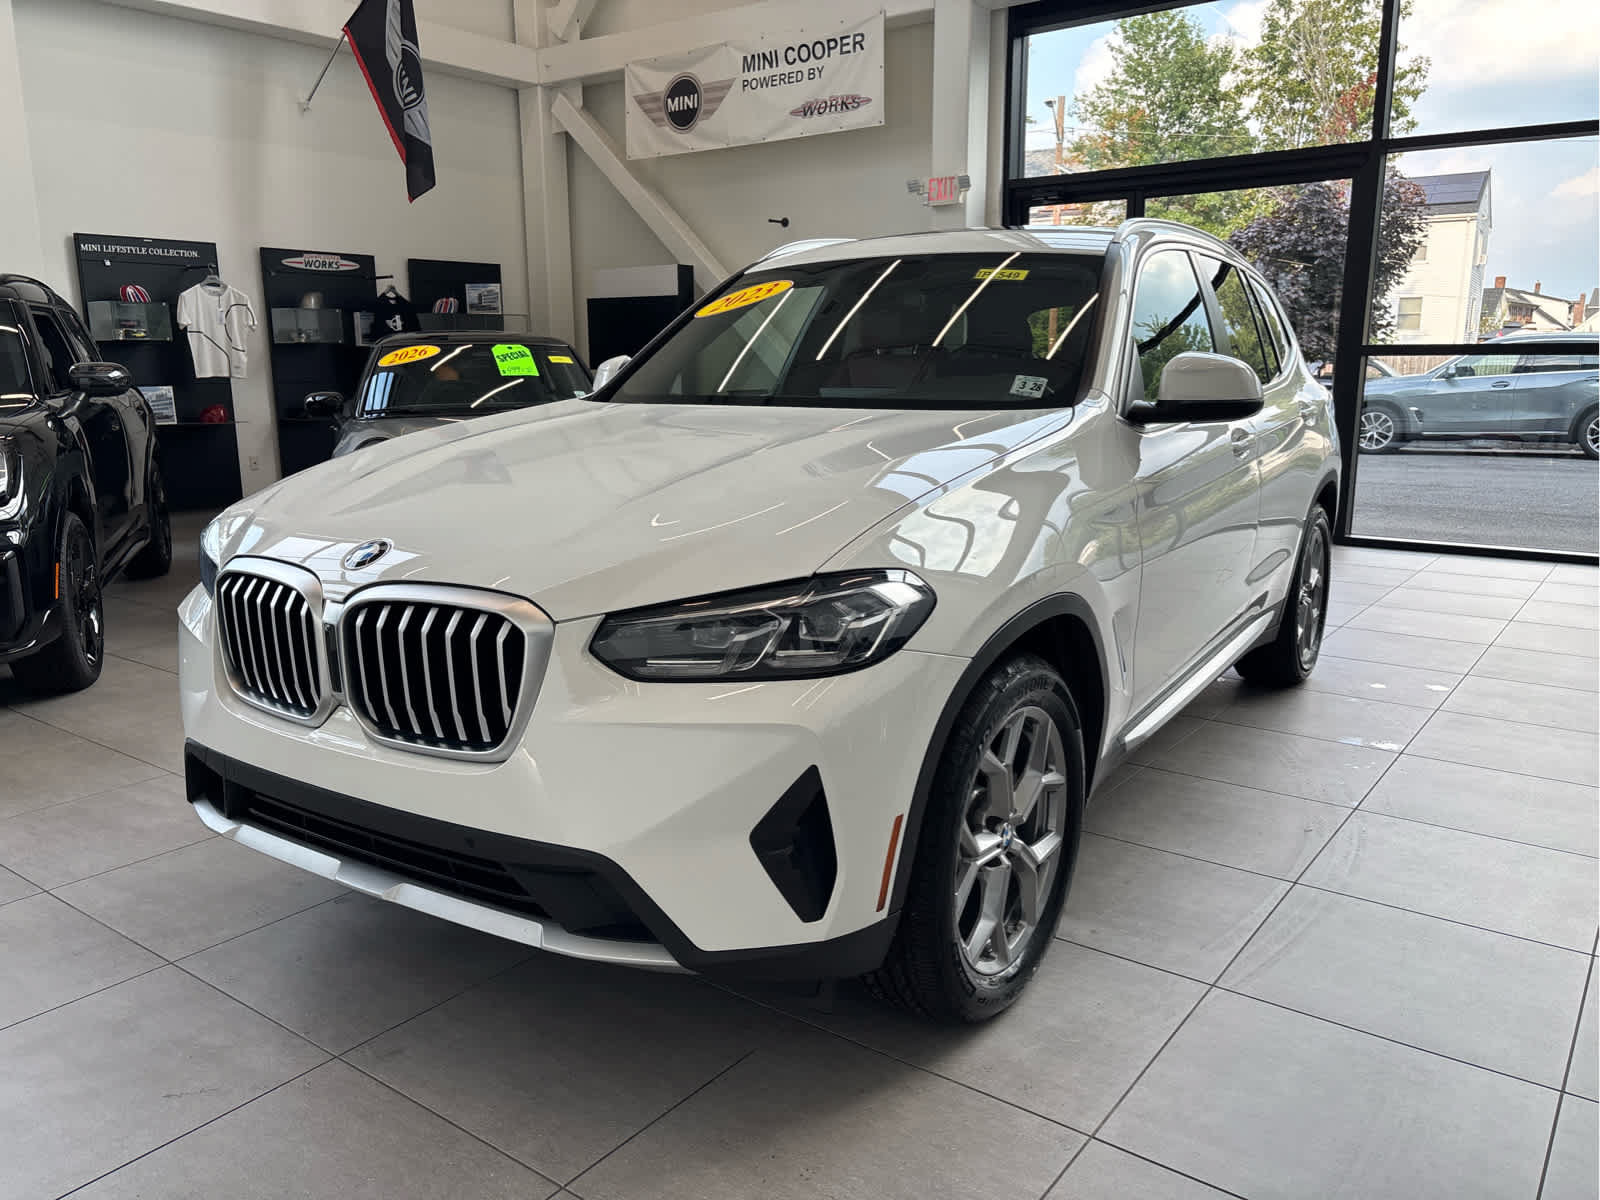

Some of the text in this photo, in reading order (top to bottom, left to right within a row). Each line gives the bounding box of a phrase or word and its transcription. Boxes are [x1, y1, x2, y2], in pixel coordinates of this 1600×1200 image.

[742, 33, 865, 73] MINI COOPER
[742, 66, 825, 92] POWERED BY
[667, 93, 698, 113] MINI
[802, 97, 861, 117] WORKS
[928, 176, 955, 201] EXIT
[80, 244, 101, 252] MINI
[103, 245, 147, 255] LIFESTYLE
[304, 259, 341, 270] WORKS
[706, 283, 779, 313] 2023
[387, 349, 427, 364] 2026
[496, 349, 530, 363] SPECIAL
